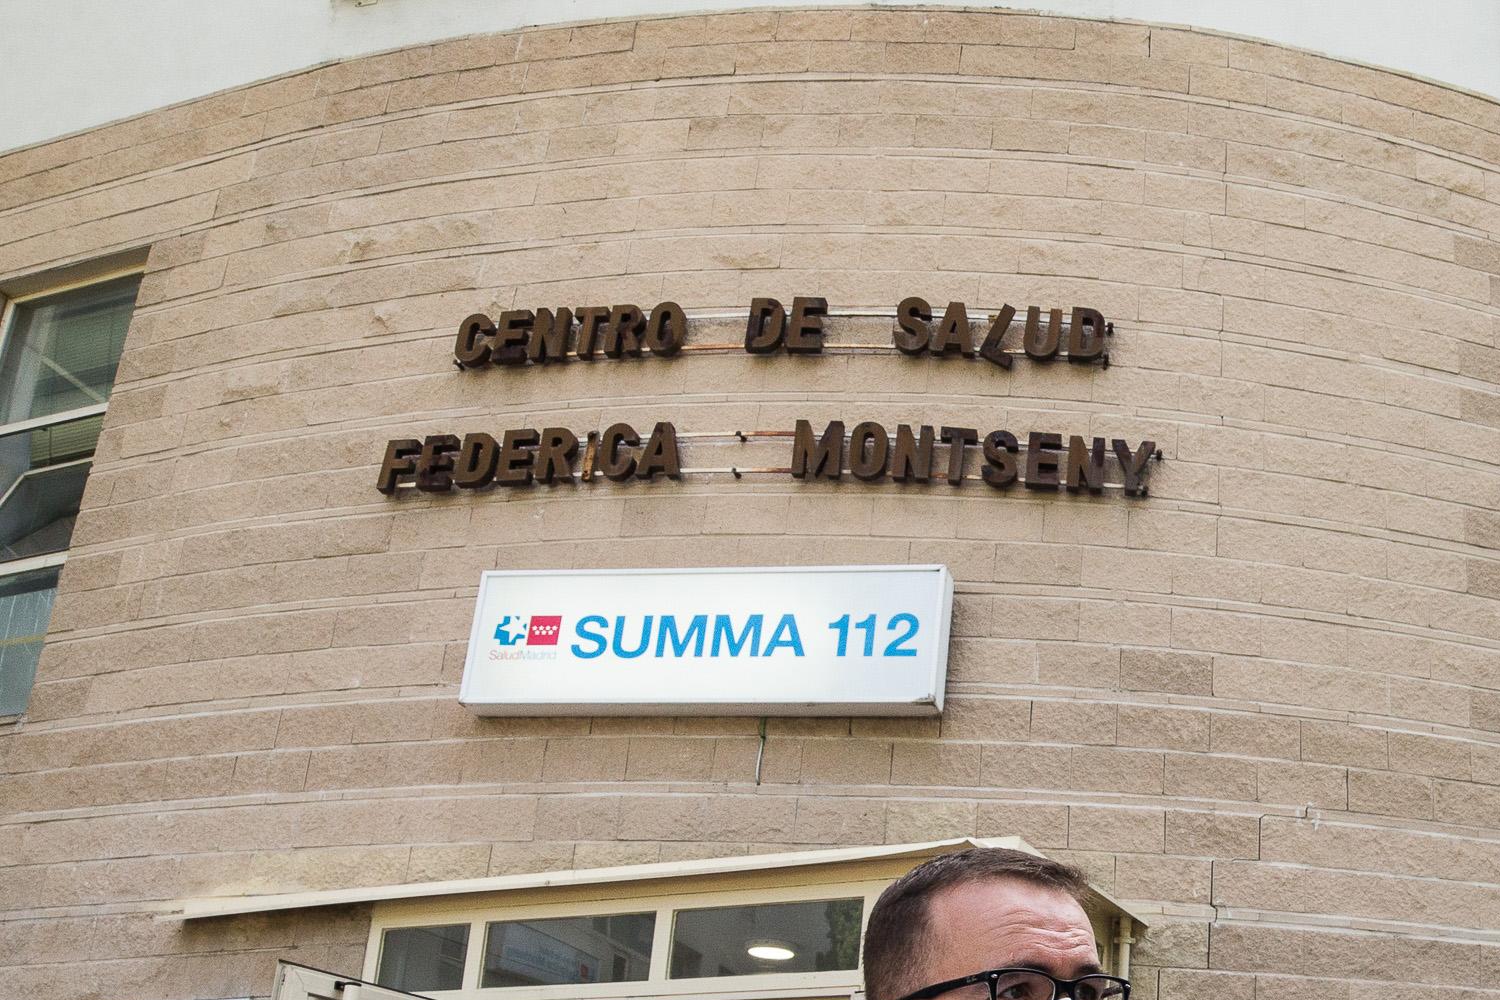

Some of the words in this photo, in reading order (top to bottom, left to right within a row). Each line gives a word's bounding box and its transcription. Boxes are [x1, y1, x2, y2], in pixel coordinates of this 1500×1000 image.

[455, 301, 686, 367] CENTRO
[745, 297, 828, 355] DE
[894, 297, 1106, 370] SALUD
[376, 421, 681, 495] FEDERICA
[791, 419, 1156, 497] MONTSENY
[570, 614, 805, 659] SUMMA
[828, 614, 919, 657] 112
